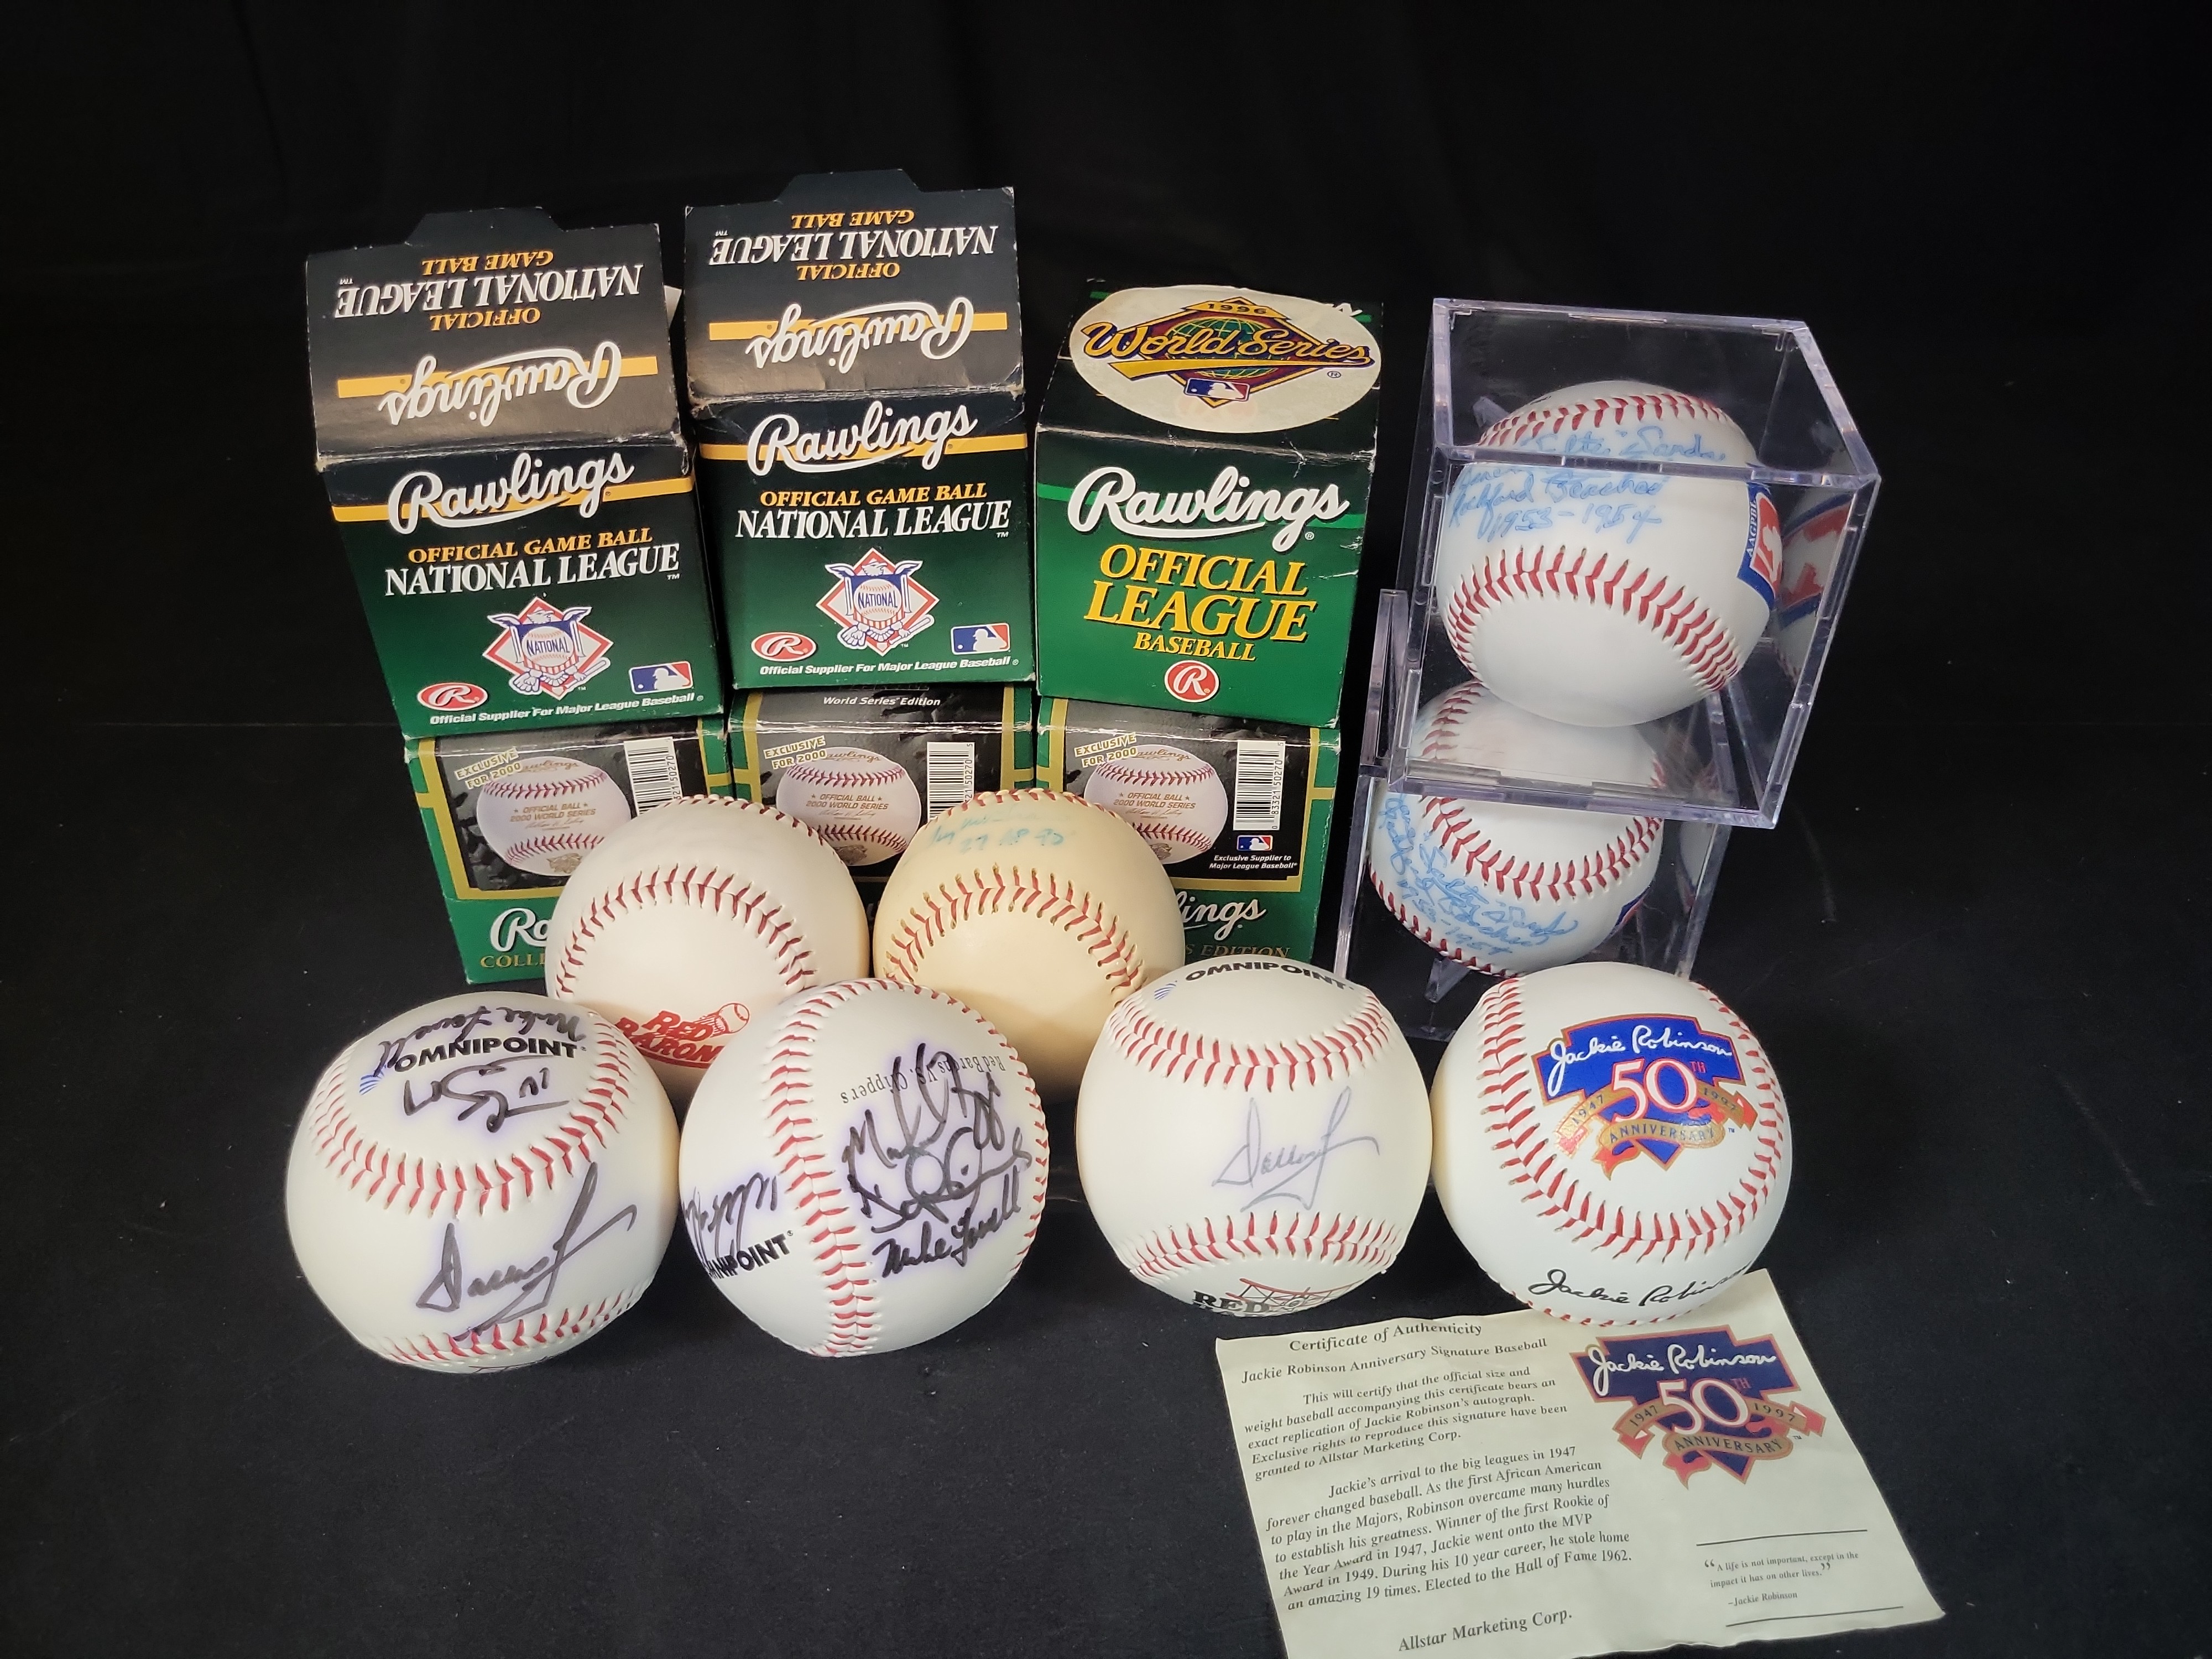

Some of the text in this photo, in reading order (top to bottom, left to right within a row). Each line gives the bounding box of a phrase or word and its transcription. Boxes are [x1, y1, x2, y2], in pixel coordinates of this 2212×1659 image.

[792, 210, 915, 229] GAME BALL
[709, 225, 999, 266] NATIONAL LEAGUE
[422, 251, 554, 275] GAME BALL
[797, 262, 900, 281] OFFICIAL
[335, 264, 644, 318] NATIONAL LEAGUE
[430, 307, 541, 331] OFFICIAL
[1207, 302, 1268, 316] 1996
[745, 297, 974, 373] Rawlings
[1081, 321, 1373, 362] World Series
[378, 341, 622, 427] Rawlings
[747, 400, 978, 476] Rawlings
[388, 452, 635, 534] Rawlings
[760, 483, 987, 507] OFFICIAL GAME BALL
[735, 500, 1011, 539] NATIONAL LEAGUE
[1067, 466, 1350, 552] Rawlings
[408, 528, 653, 564] OFFICIAL GAME BALL
[385, 543, 680, 597] NATIONAL LEAGUE
[1100, 544, 1308, 596] OFFICIAL
[858, 593, 898, 609] NATIONAL
[1084, 580, 1317, 642] LEAGUE
[526, 638, 570, 655] NATIONAL
[1134, 632, 1256, 661] BASEBALL
[760, 656, 1010, 675] Official Supplier For Major League Baseball
[430, 693, 695, 725] Official Supplier For Major League Baseball
[859, 697, 896, 705] Series
[900, 697, 941, 706] Edition
[765, 737, 823, 757] EXCLUSIVE
[773, 750, 826, 768] FOR 2000
[1076, 734, 1136, 755] EXCLUSIVE
[1083, 748, 1137, 767] FOR 2000
[457, 750, 517, 778] EXCLUSIVE
[468, 775, 491, 788] FOR
[493, 763, 521, 779] 2000
[1271, 759, 1282, 816] 83321 50270
[1201, 945, 1291, 958] EDITION
[642, 1010, 713, 1041] RED
[1547, 1025, 1732, 1097] Jackie Robinson
[1572, 1094, 1604, 1125] 1947
[1609, 1123, 1714, 1144] ANNIVERSARY
[1289, 1322, 1482, 1352] Certificate of Authenticity
[1241, 1338, 1547, 1384] Jackie Robinson Anniversary Signature Baseball
[1588, 1344, 1776, 1396] Jackie Robinson
[1303, 1367, 1530, 1406] This will certify that the official size and
[1630, 1402, 1795, 1426] 1947 1997
[1675, 1437, 1782, 1454] ANNIVERSARY
[1380, 1465, 1421, 1485] arrival
[1425, 1465, 1436, 1475] to
[1440, 1460, 1459, 1472] the
[1463, 1457, 1483, 1470] big
[1485, 1452, 1529, 1465] leagues
[1532, 1450, 1545, 1459] in
[1550, 1447, 1576, 1458] 1947
[1288, 1550, 1632, 1610] an amazing 19 times. Elected to the Hall of Fame 1962.
[1710, 1578, 1738, 1588] impact
[1749, 1574, 1764, 1582] has
[1779, 1570, 1799, 1578] other
[1761, 1591, 1798, 1601] Robinson
[1399, 1609, 1572, 1651] Allstar Marketing Corp.
